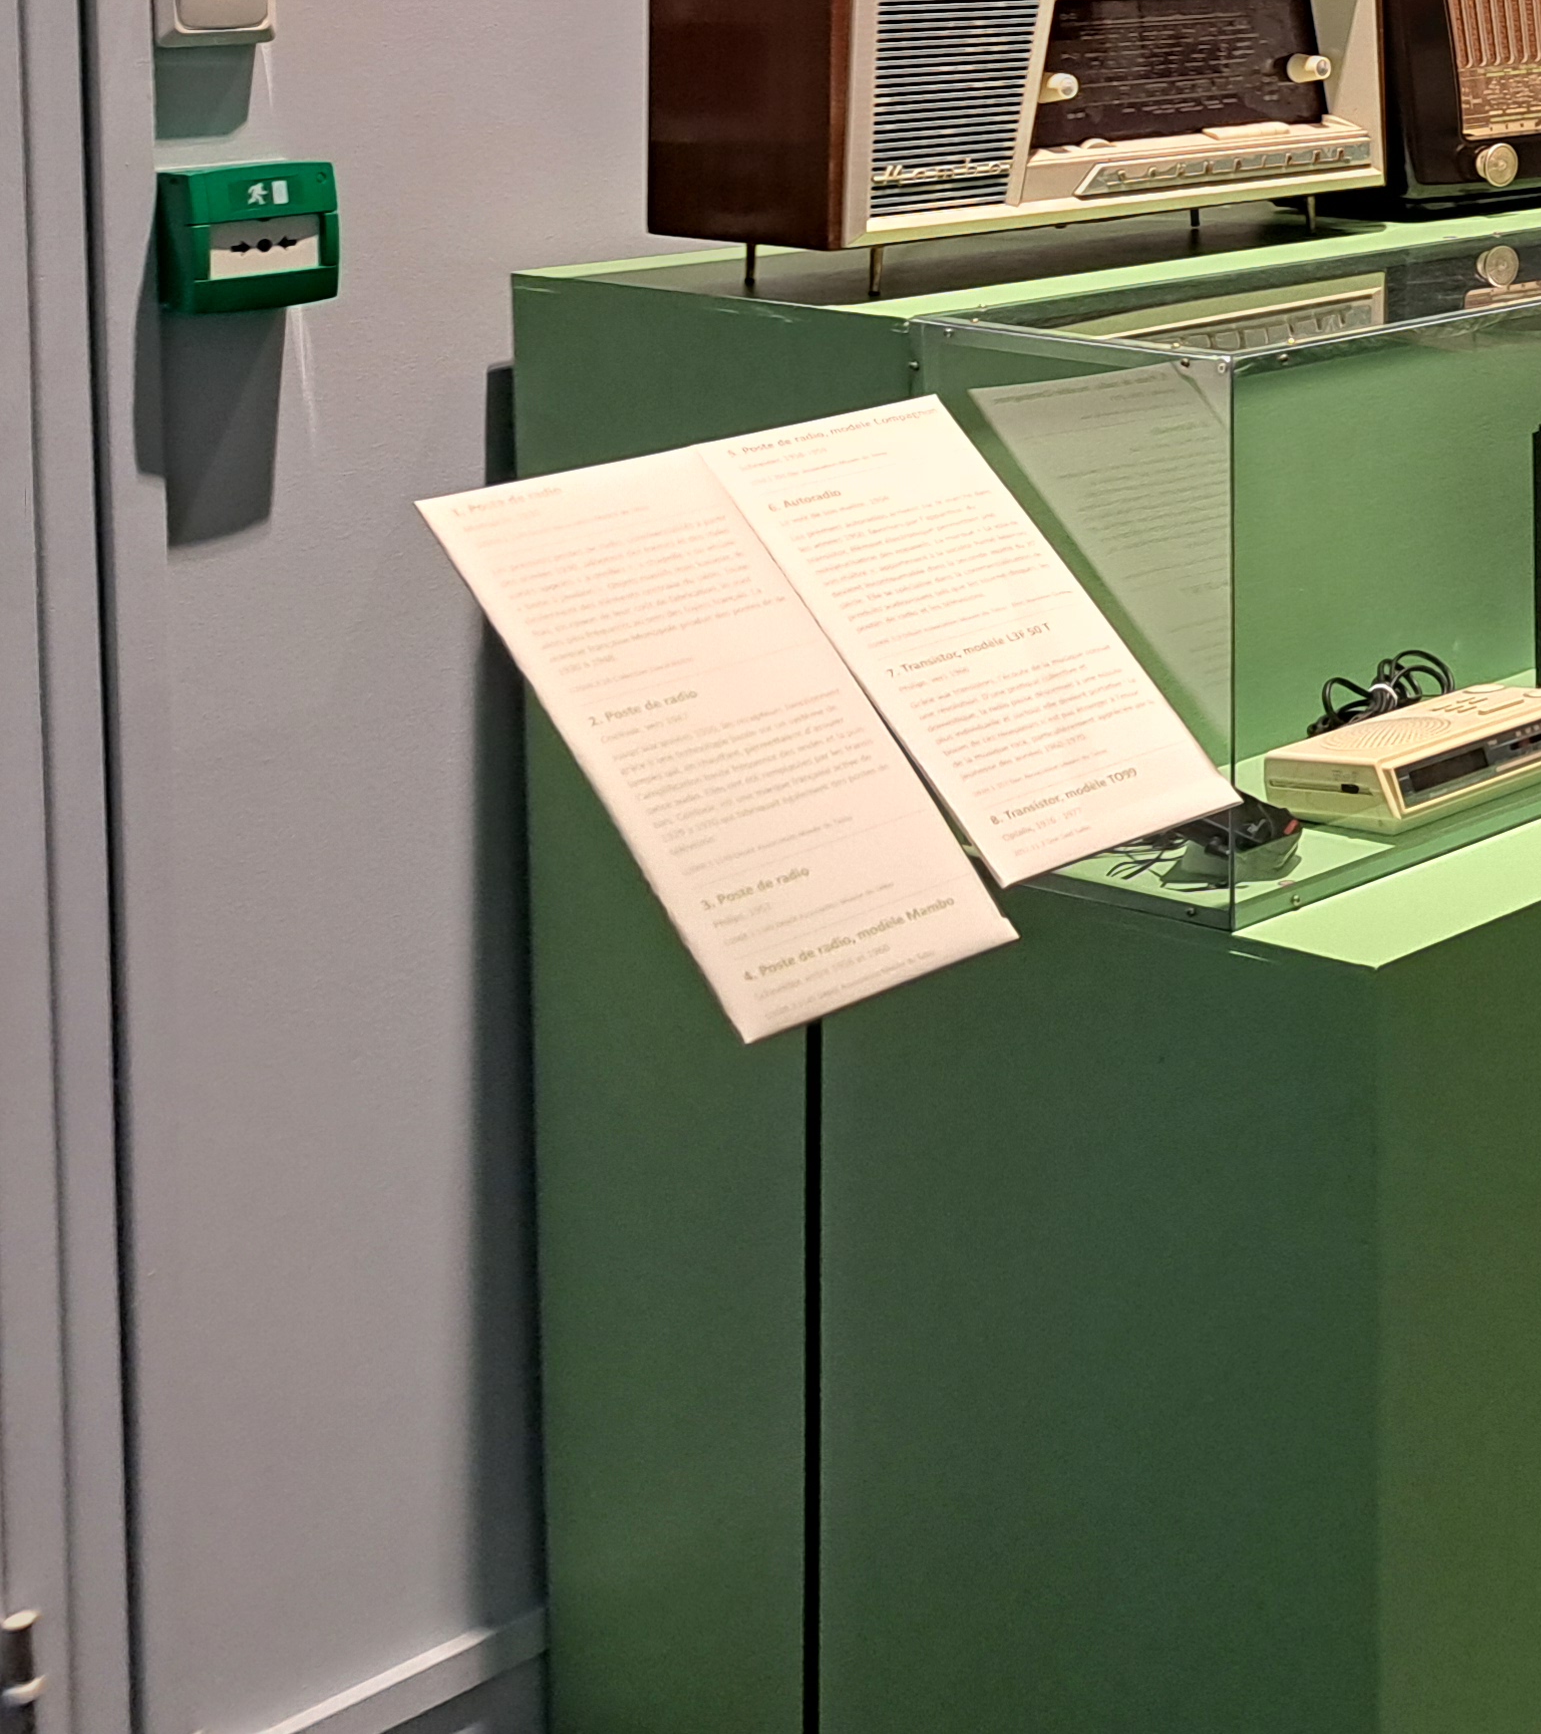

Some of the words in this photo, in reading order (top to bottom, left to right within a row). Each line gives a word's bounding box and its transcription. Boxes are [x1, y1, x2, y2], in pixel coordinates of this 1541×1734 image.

[742, 444, 773, 454] Poste
[783, 491, 841, 508] Autoradio
[900, 652, 962, 672] Transistor,
[963, 638, 1004, 655] modèle
[588, 716, 603, 727] 2.
[604, 706, 641, 722] Poste
[645, 700, 661, 710] de
[664, 691, 698, 705] radio
[1004, 795, 1064, 819] Transistor,
[1065, 780, 1107, 798] modèle
[701, 900, 715, 910] 3.
[716, 887, 753, 905] Poste
[757, 880, 773, 891] de
[776, 868, 809, 884] radio
[744, 971, 757, 980] 4.
[758, 957, 795, 976] Poste
[799, 950, 815, 961] de
[817, 937, 856, 954] radio,
[857, 917, 905, 939] modèle
[906, 898, 955, 920] Mambo
